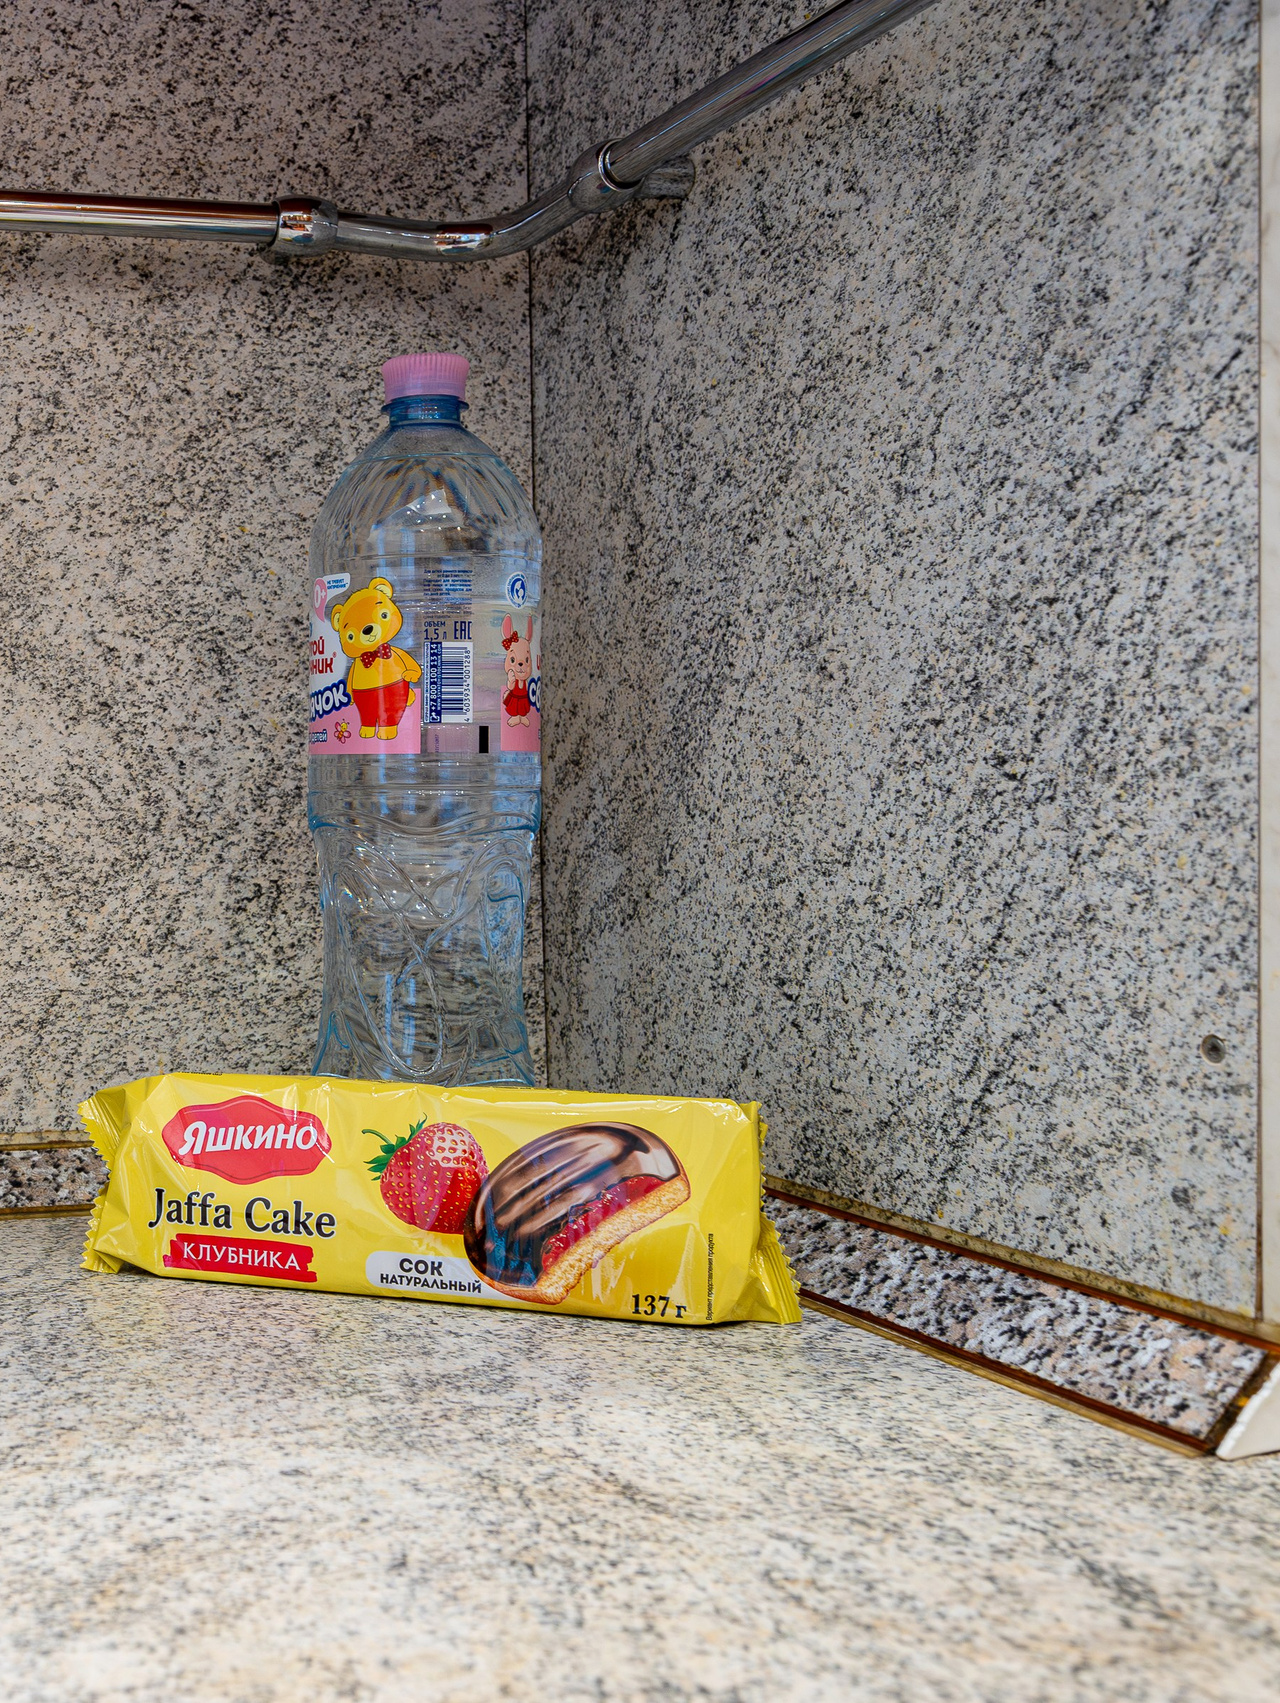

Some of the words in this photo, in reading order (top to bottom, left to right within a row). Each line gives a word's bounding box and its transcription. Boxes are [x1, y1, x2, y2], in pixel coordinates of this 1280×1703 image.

[314, 584, 326, 609] 0+
[423, 628, 439, 641] 1,5
[148, 1187, 233, 1230] Jaffa
[244, 1196, 338, 1239] Cake
[183, 1242, 302, 1271] КЛУБНИКА
[399, 1257, 444, 1277] СОК
[380, 1273, 482, 1294] НАТУРАЛЬНЫЙ
[631, 1293, 670, 1317] 137
[676, 1304, 688, 1319] г
